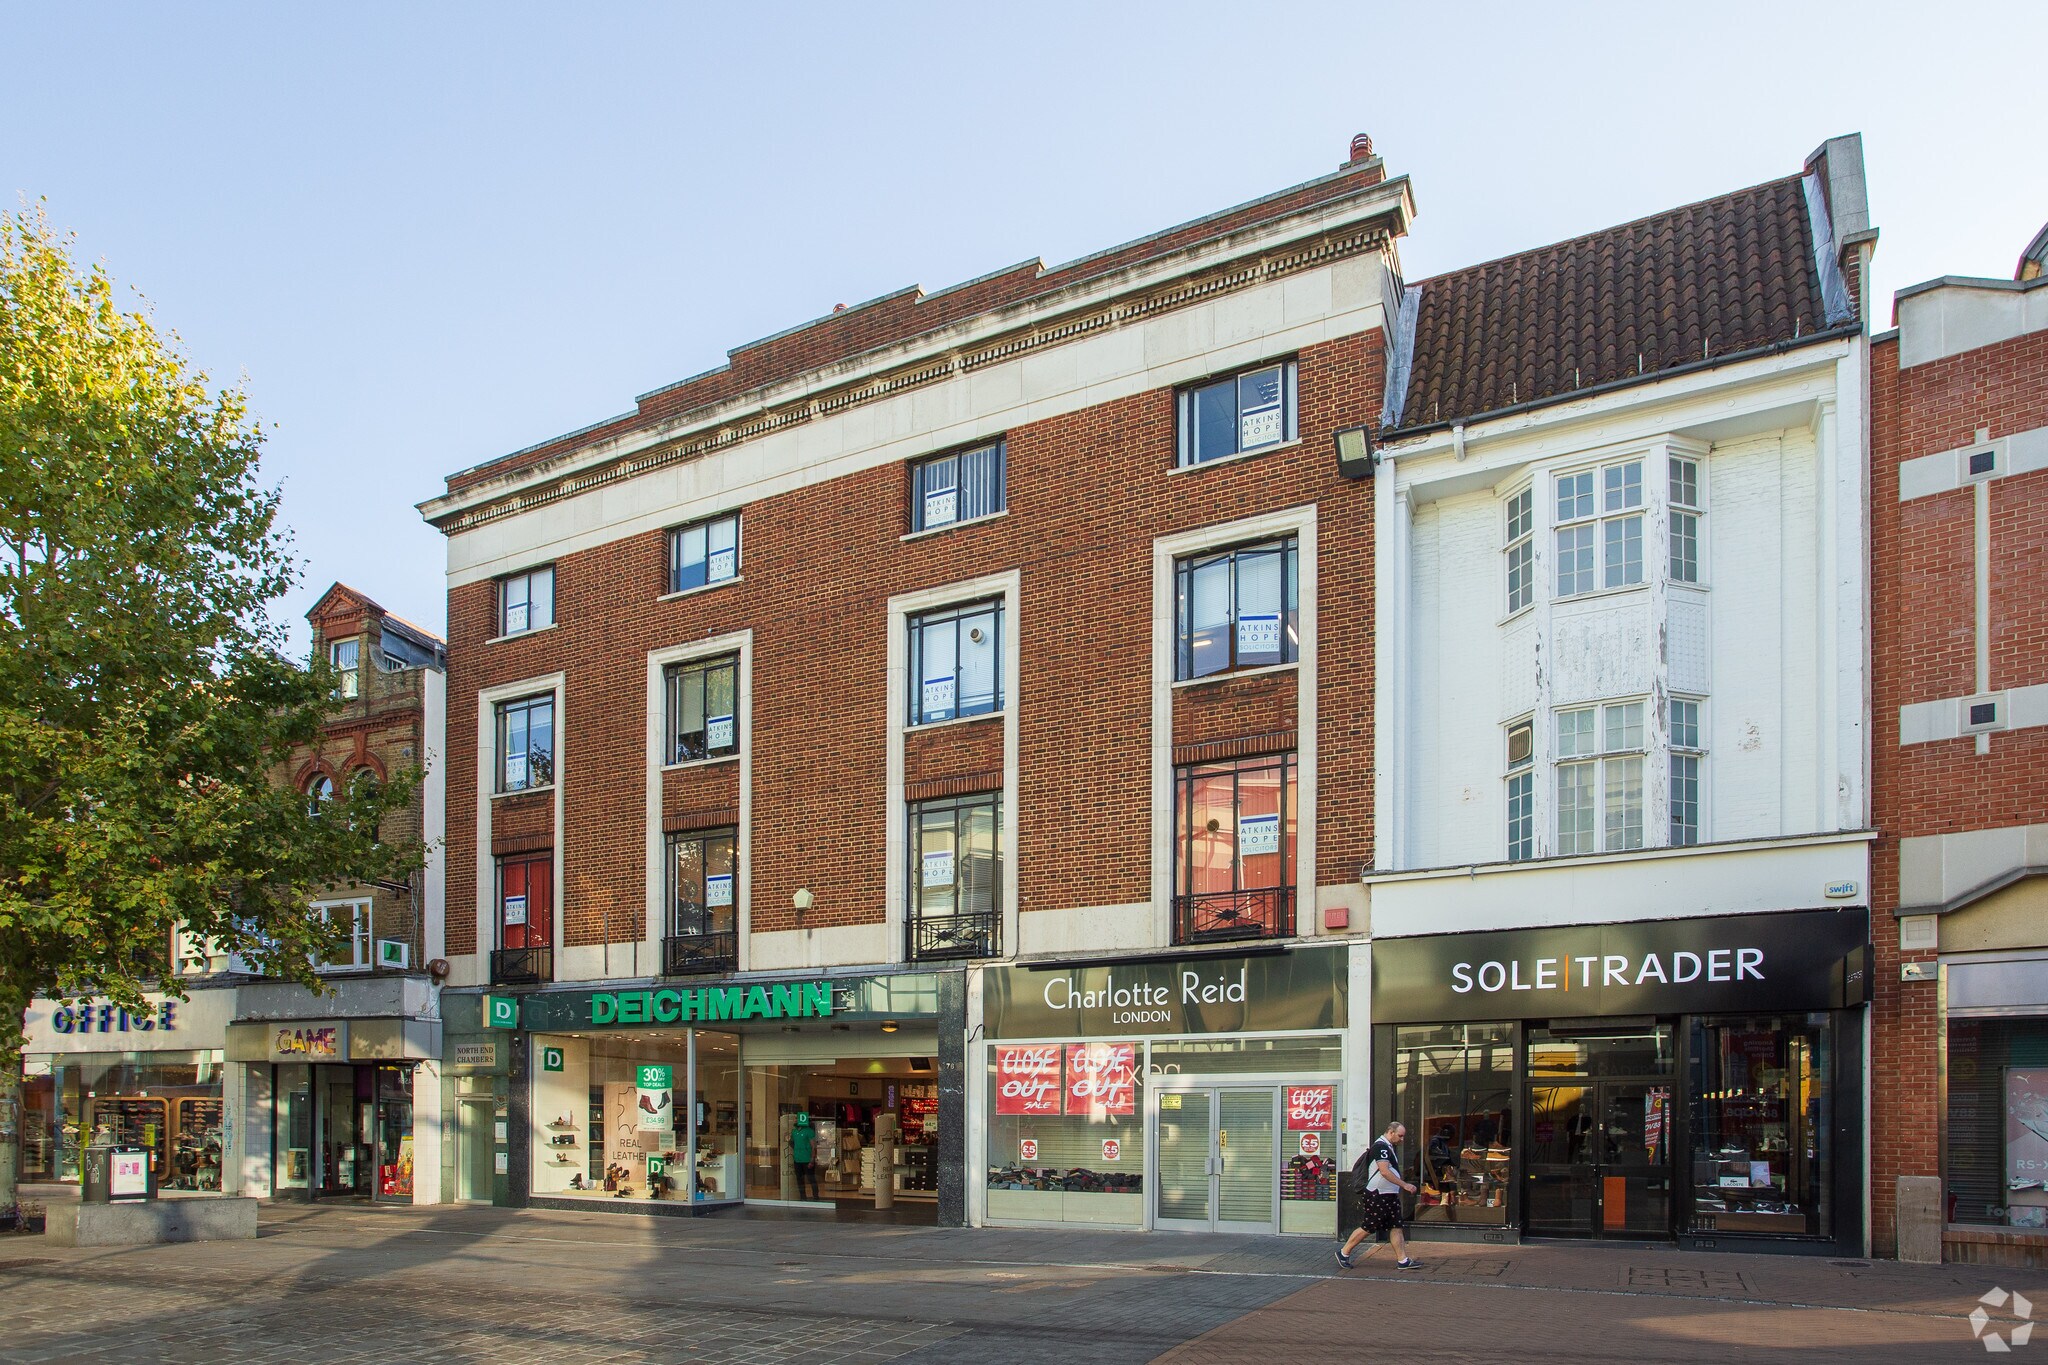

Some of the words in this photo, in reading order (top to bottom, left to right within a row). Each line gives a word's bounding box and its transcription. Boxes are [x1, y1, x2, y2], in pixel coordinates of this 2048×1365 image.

[1243, 412, 1280, 427] ATKINS
[1243, 422, 1280, 437] HOPE
[927, 496, 956, 507] ATKINS
[927, 504, 955, 516] HOPE
[710, 554, 734, 564] ATKINS
[710, 562, 734, 572] HOPE
[1240, 623, 1279, 631] ATKINS
[1240, 633, 1279, 642] HOPE
[925, 683, 954, 694] ATKINS
[925, 692, 953, 702] HOPE
[708, 723, 733, 732] ATKINS
[708, 731, 732, 740] HOPE
[1241, 824, 1278, 834] ATKINS
[1241, 834, 1278, 844] HOPE
[925, 860, 953, 868] ATKINS
[925, 869, 953, 877] HOPE
[708, 882, 732, 890] ATKINS
[1829, 883, 1854, 894] swift
[708, 890, 731, 898] HOPE
[1451, 958, 1557, 994] SOLE
[1574, 948, 1766, 988] TRADER
[1043, 975, 1169, 1010] Charlotte
[1182, 968, 1245, 1004] Reid
[592, 982, 834, 1024] DEICHMANN
[496, 1002, 511, 1019] D
[52, 1002, 173, 1034] OFFICE
[1113, 1010, 1171, 1024] LONDON
[275, 1027, 337, 1055] GAME
[548, 1051, 561, 1068] D
[1001, 1048, 1058, 1078] CLOSE
[1071, 1047, 1131, 1078] CLOSE
[643, 1068, 665, 1082] 30%
[851, 1084, 858, 1093] D
[1000, 1078, 1056, 1102] OUT
[1070, 1077, 1130, 1101] OUT
[1291, 1089, 1329, 1108] CLOSE
[1024, 1101, 1052, 1110] SALE
[800, 1114, 807, 1122] D
[1290, 1107, 1329, 1122] OUT
[620, 1139, 642, 1149] REAL
[1302, 1139, 1318, 1148] £5
[1022, 1145, 1036, 1154] £5
[1104, 1145, 1118, 1154] £5
[1380, 1149, 1388, 1159] 3
[650, 1160, 662, 1174] D
